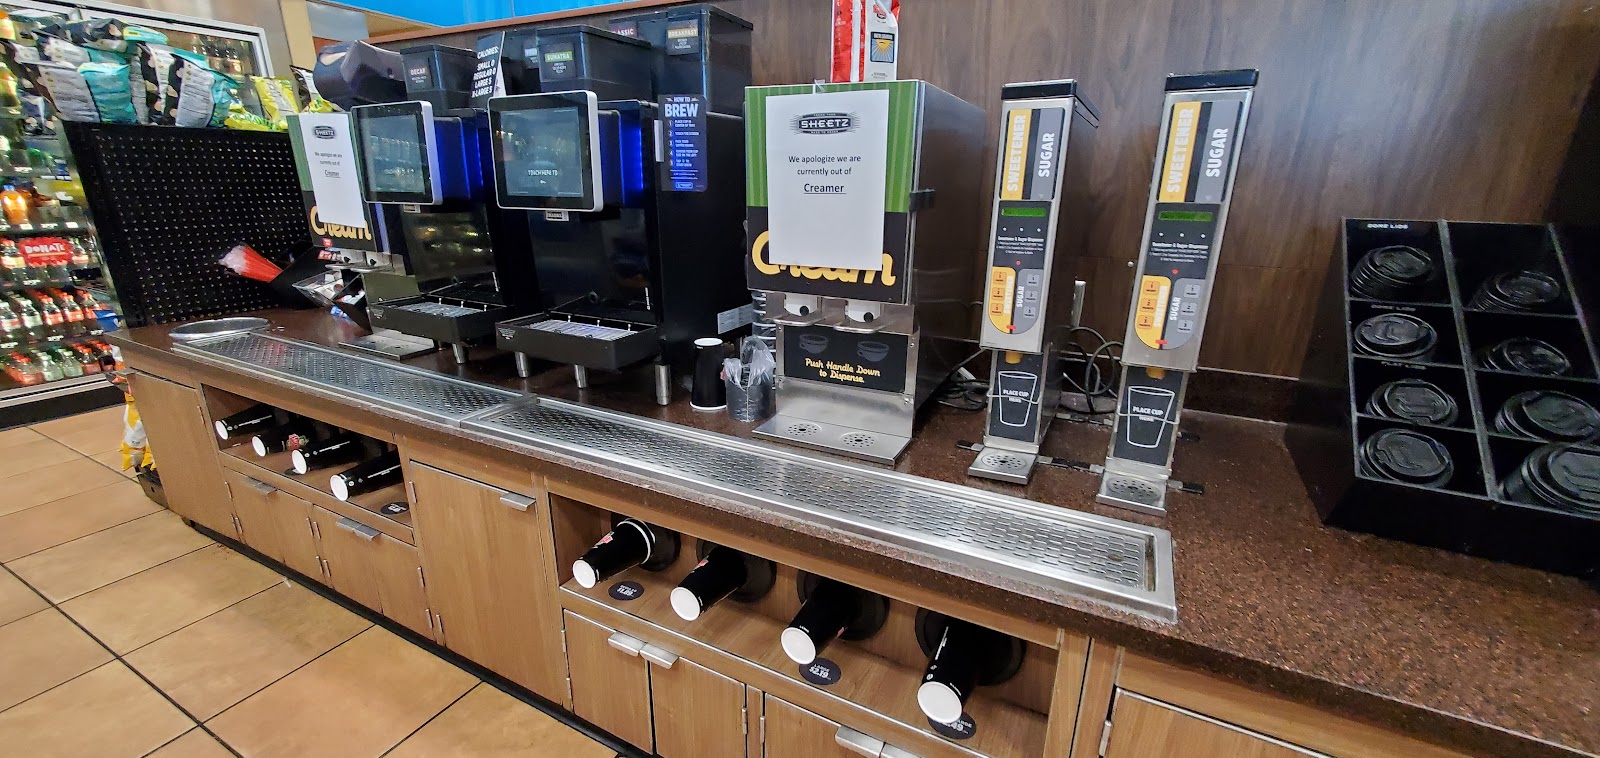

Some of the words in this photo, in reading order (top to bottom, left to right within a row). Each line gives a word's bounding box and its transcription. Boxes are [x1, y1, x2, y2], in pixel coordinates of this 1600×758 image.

[668, 29, 697, 38] BREAKFAST
[477, 46, 499, 59] CALORIES:
[477, 61, 490, 71] SMALL
[473, 69, 492, 80] REGULAR
[474, 79, 489, 89] LARGE
[664, 103, 699, 118] BREW
[801, 118, 849, 129] SHEETZ
[1007, 115, 1026, 192] SWEETENER
[1038, 132, 1055, 178] SUGAR
[1166, 108, 1194, 193] SWEETENER
[1206, 128, 1228, 178] SUGAR
[802, 155, 835, 164] apologize
[797, 167, 829, 176] currently
[844, 167, 852, 175] of
[804, 183, 845, 193] Creamer
[1016, 286, 1025, 308] SUGAR
[1169, 296, 1182, 321] SUGAR
[805, 358, 824, 368] Push
[826, 361, 854, 372] Handle
[856, 365, 881, 377] Down
[819, 369, 828, 377] to
[809, 666, 828, 678] $2.19
